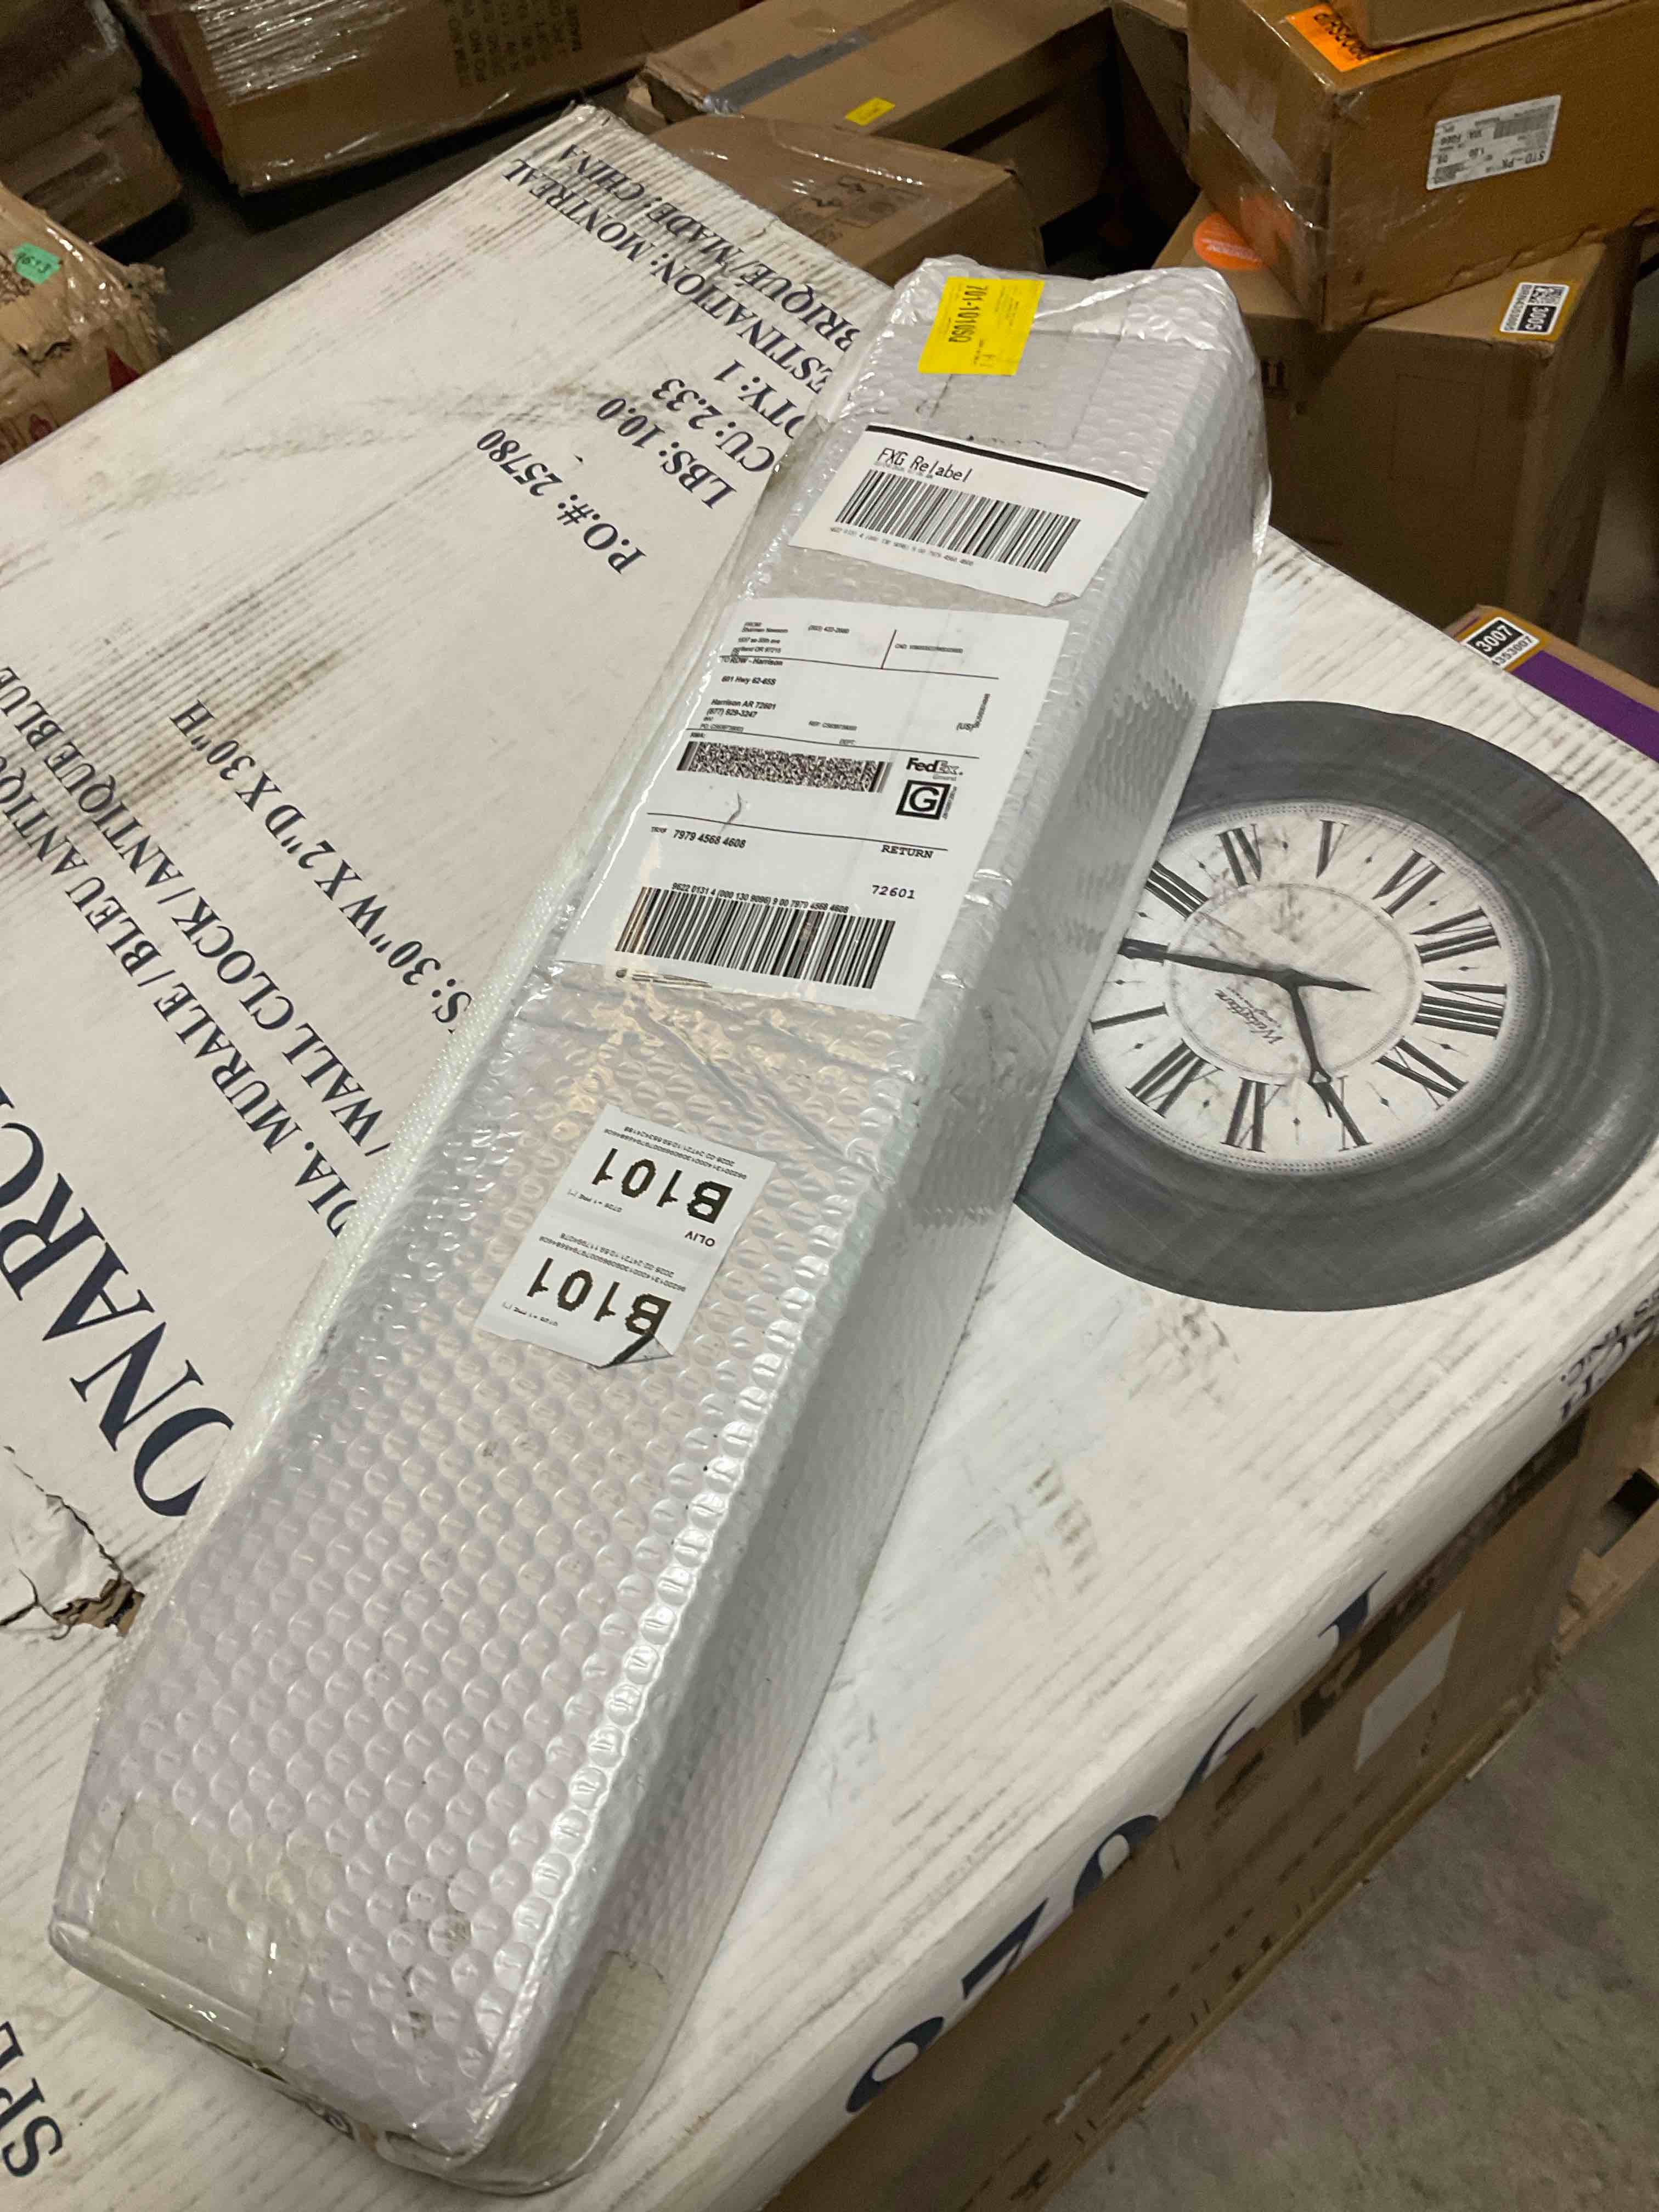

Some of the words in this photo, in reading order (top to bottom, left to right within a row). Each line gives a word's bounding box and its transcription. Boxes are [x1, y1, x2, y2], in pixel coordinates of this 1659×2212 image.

[556, 143, 645, 203] CHINA
[502, 157, 656, 263] MONTREAL
[1525, 306, 1548, 332] 3005
[713, 359, 744, 383] 1
[596, 397, 667, 450] 10.0
[651, 377, 720, 431] 2.33
[476, 428, 563, 497] 25780
[714, 420, 776, 473] CU:
[878, 447, 905, 467] FXG
[912, 455, 973, 483] Relabel
[658, 439, 737, 510] LBS:
[1475, 624, 1515, 653] 3007
[711, 699, 741, 708] Harrison
[742, 699, 754, 708] AR
[755, 701, 777, 710] 72601
[735, 675, 751, 685] Hwy
[0, 665, 65, 751] BLUE
[233, 771, 282, 812] X
[906, 757, 959, 775] FedEx
[43, 742, 185, 889] ANTIQUE
[908, 786, 941, 812] G
[263, 803, 337, 871] 2"D
[673, 828, 697, 841] 7979
[697, 831, 721, 845] 4568
[721, 835, 747, 849] 4608
[880, 844, 934, 859] RETURN
[156, 885, 198, 905] /
[313, 857, 363, 900] X
[871, 884, 916, 900] 72601
[65, 874, 163, 979] BLEU
[137, 969, 177, 988] /
[171, 895, 295, 1030] CLOCK
[153, 982, 303, 1154] MURALE
[281, 1022, 385, 1147] WALL
[591, 1147, 733, 1224] B101
[684, 1230, 716, 1248] OLIV
[0, 1085, 235, 1518] ONARC
[526, 1257, 672, 1337] B101
